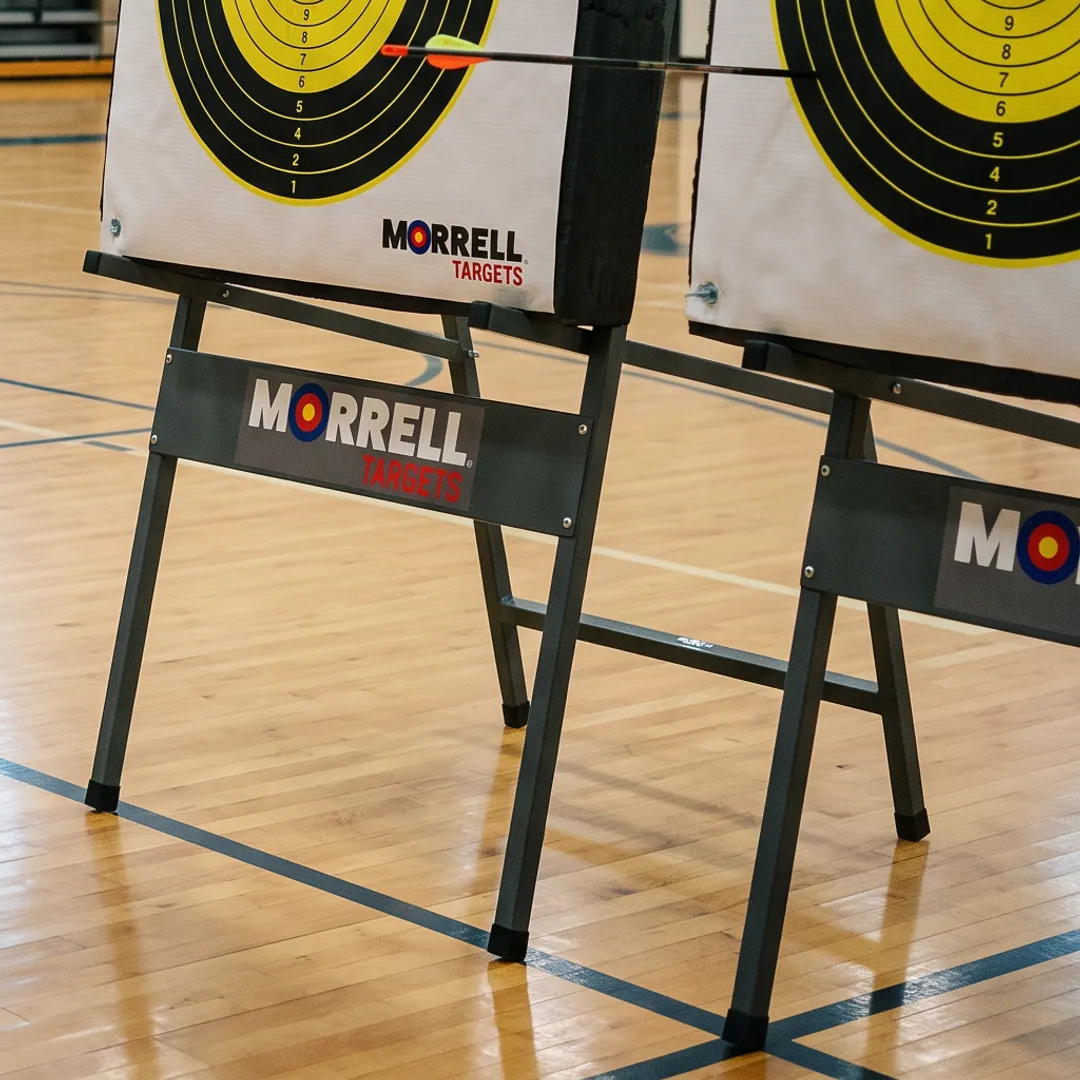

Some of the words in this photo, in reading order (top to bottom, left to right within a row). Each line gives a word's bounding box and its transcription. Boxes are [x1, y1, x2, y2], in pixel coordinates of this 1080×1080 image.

[303, 8, 310, 21] 9
[1004, 15, 1015, 32] 9
[301, 31, 308, 44] 8
[300, 52, 307, 66] 7
[1001, 43, 1012, 60] 8
[298, 75, 305, 89] 6
[999, 71, 1010, 88] 7
[296, 100, 303, 113] 5
[995, 100, 1007, 117] 6
[293, 127, 302, 140] 4
[992, 131, 1004, 148] 5
[292, 153, 300, 166] 2
[989, 166, 1000, 183] 4
[986, 199, 998, 216] 2
[382, 218, 522, 262] MORRELL
[985, 233, 992, 250] 1
[452, 259, 523, 286] TARGETS
[248, 378, 467, 467] MORRELL
[362, 454, 462, 503] TARGETS
[954, 500, 1080, 586] MO
